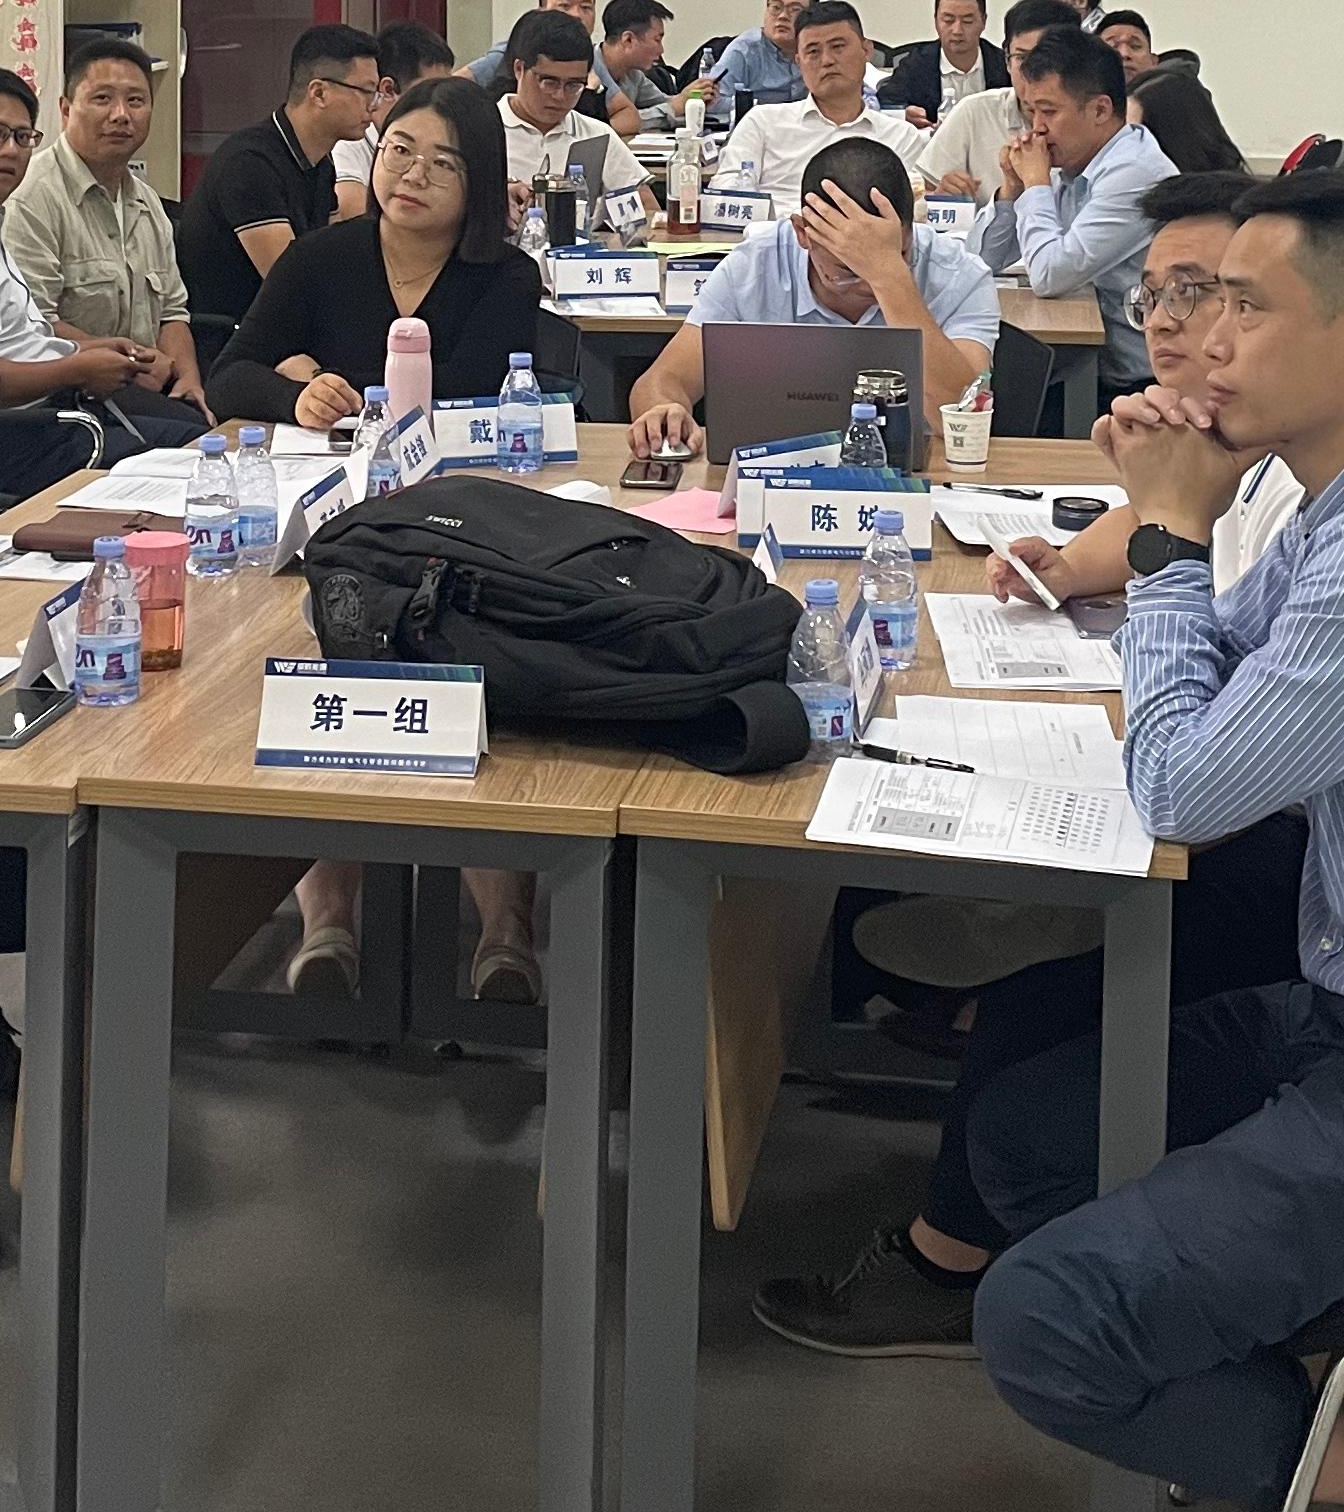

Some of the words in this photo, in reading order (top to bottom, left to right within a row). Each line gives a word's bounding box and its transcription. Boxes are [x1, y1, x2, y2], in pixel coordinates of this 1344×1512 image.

[786, 391, 840, 402] HUAWEI
[309, 693, 430, 735] 第一组
